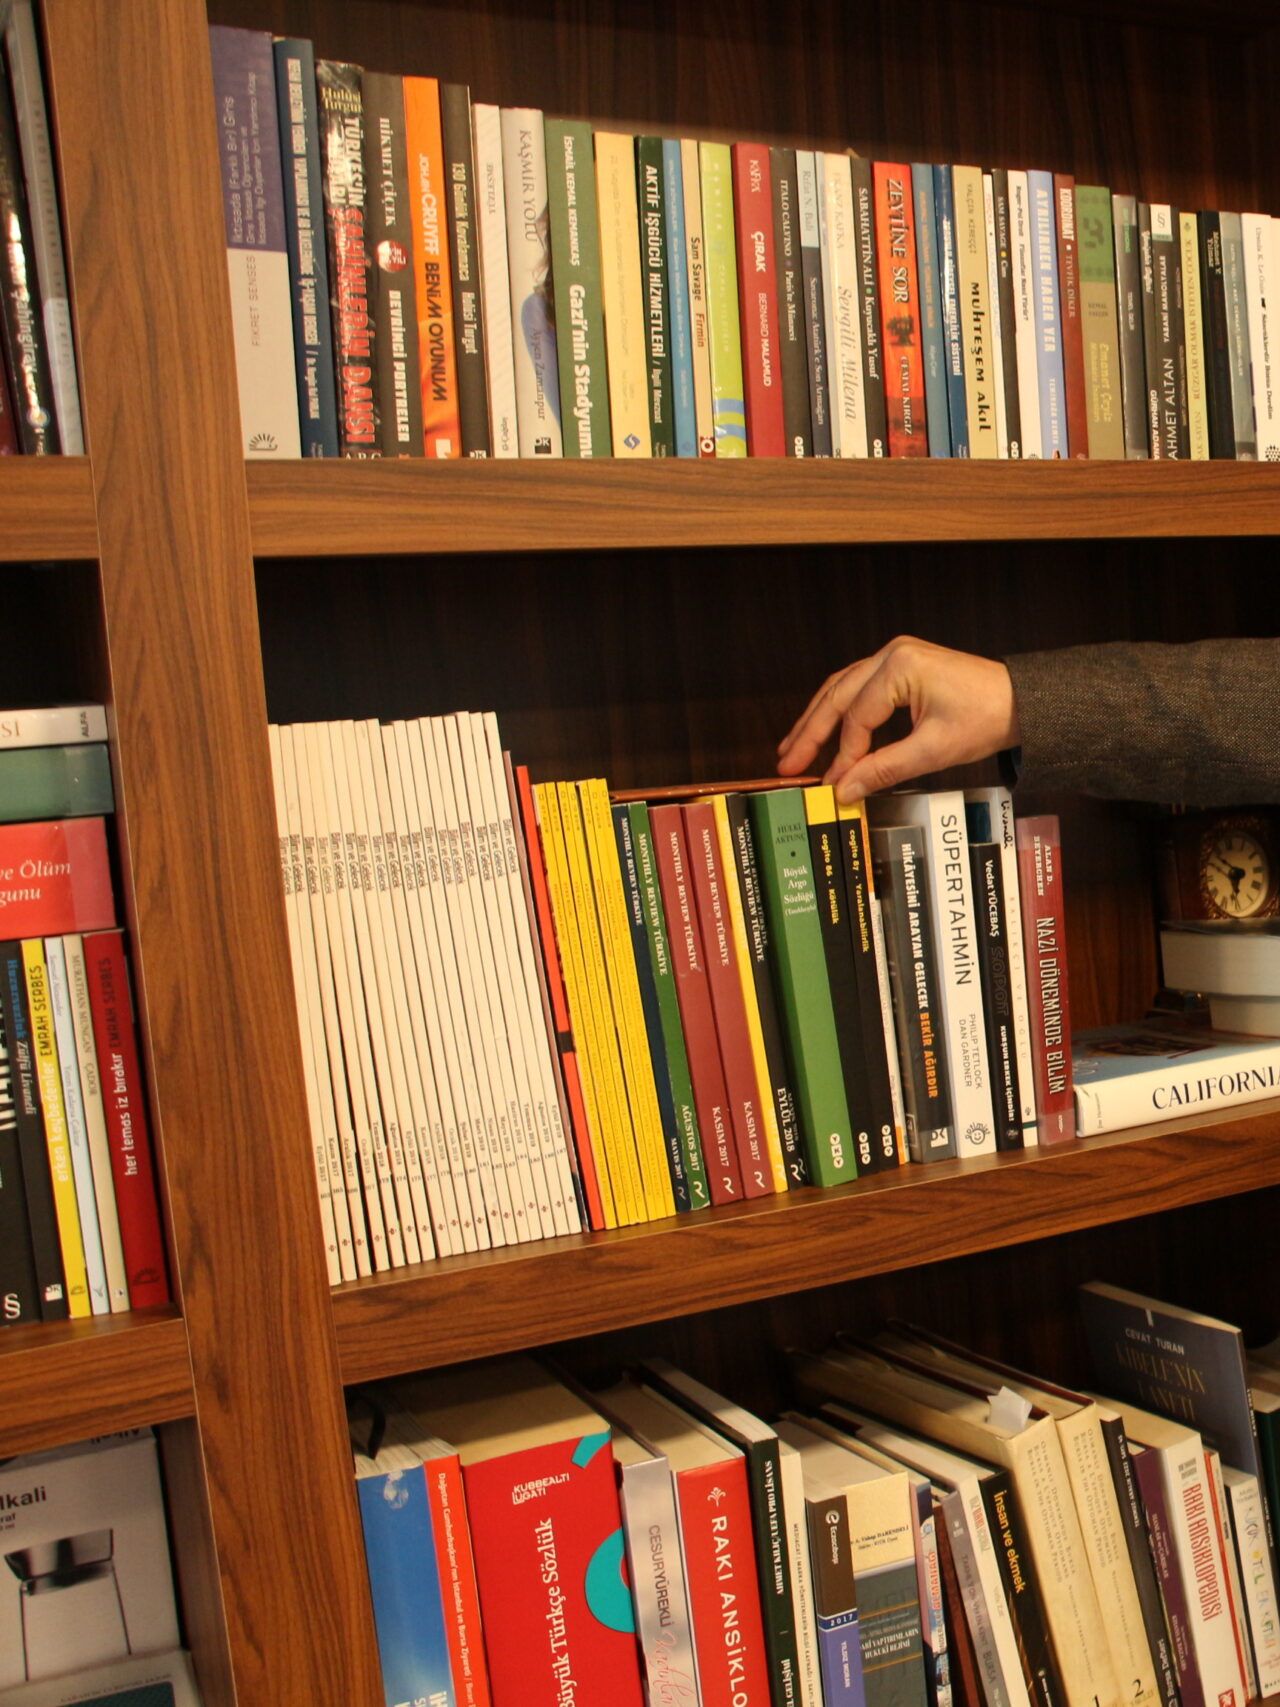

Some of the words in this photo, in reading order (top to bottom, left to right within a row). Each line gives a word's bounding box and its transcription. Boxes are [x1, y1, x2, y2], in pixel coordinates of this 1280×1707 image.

[380, 117, 393, 178] HİKMET
[518, 130, 535, 194] KAŞMİR
[564, 136, 575, 170] İSMAİL
[452, 163, 466, 181] 130
[566, 172, 576, 206] KEMAL
[645, 165, 659, 208] AKTİF
[381, 181, 397, 226] ÇİÇEK
[422, 193, 439, 256] CRUYFF
[523, 198, 537, 243] YOLU
[858, 187, 873, 264] SABAHATTİN
[887, 179, 908, 258] ZEYTİNE
[568, 208, 580, 266] KEMANKAŞ
[645, 212, 662, 267] İŞGÜCÜ
[690, 237, 700, 259] Sam
[751, 231, 766, 272] ÇIRAK
[783, 212, 792, 256] CALVINO
[692, 263, 702, 301] Savage
[863, 265, 874, 285] ALİ
[893, 266, 909, 303] SOR
[648, 272, 665, 357] HİZMETLERİ
[758, 293, 768, 337] BERNARD
[836, 286, 856, 349] Sevgili
[1041, 277, 1054, 321] HABER
[695, 313, 705, 347] Firmin
[1044, 328, 1055, 352] VER
[428, 323, 447, 401] OYUNUM
[761, 338, 772, 386] MALAMUD
[868, 348, 879, 379] Yusuf
[1163, 359, 1175, 406] ALTAN
[342, 366, 375, 443] DANSI
[393, 361, 410, 442] PORTRELER
[842, 354, 858, 424] Milena
[1165, 411, 1177, 461] AHMET
[821, 834, 831, 863] cogito
[849, 830, 859, 858] cogito
[1044, 845, 1052, 872] ALAN
[21, 859, 71, 881] Ölüm
[826, 865, 832, 876] 86
[902, 843, 920, 908] HİKÂYESİNİ
[985, 860, 996, 889] Vedat
[828, 889, 839, 924] Kötülük
[941, 815, 975, 985] SÜPERTAHMİN
[987, 891, 999, 937] YÜCEBAŞ
[908, 912, 923, 958] ARAYAN
[1037, 917, 1058, 953] NAZİ
[29, 966, 46, 1010] SERBES
[639, 833, 652, 884] MONTHLY
[647, 887, 659, 927] REVIEW
[654, 930, 667, 976] TÜRKİYE
[681, 1105, 696, 1150] AĞUSTOS
[690, 1152, 700, 1171] 2017
[670, 832, 682, 883] MONTHLY
[677, 885, 689, 922] REVIEW
[684, 924, 698, 970] TÜRKİYE
[712, 1107, 724, 1144] KASIM
[718, 1146, 729, 1166] 2017
[702, 829, 714, 879] MONTHLY
[709, 882, 721, 919] REVIEW
[716, 920, 729, 966] TÜRKİYE
[743, 1101, 755, 1138] KASIM
[749, 1141, 760, 1160] 2017
[737, 826, 750, 875] MONTHLY
[744, 878, 756, 916] REVIEW
[752, 919, 764, 962] TÜRKİYE
[777, 1088, 790, 1127] EYLÜL
[784, 1130, 795, 1152] 2018
[914, 962, 928, 1009] GELECEK
[1039, 957, 1063, 1047] DÖNEMİNDE
[37, 1017, 52, 1056] EMRAH
[919, 1012, 934, 1047] BEKİR
[959, 1019, 967, 1040] DAN
[969, 1014, 978, 1045] PHILIP
[924, 1051, 938, 1098] AĞIRDIR
[961, 1042, 972, 1087] GARDNER
[972, 1047, 982, 1090] TETLOCK
[1003, 1061, 1011, 1086] ERKEK
[1047, 1050, 1067, 1095] BİLİM
[21, 1073, 36, 1114] Livaneli
[41, 1062, 62, 1142] kaybedenler
[116, 1097, 128, 1108] iz
[121, 1113, 134, 1151] temas
[54, 1147, 68, 1182] erken
[124, 1154, 138, 1176] her
[514, 1473, 570, 1493] KUBBEALTI
[1183, 1483, 1207, 1521] RAKI
[994, 1490, 1009, 1529] İnsan
[535, 1518, 559, 1584] Sözlük
[712, 1516, 733, 1580] RAKI
[1003, 1531, 1014, 1546] ve
[1007, 1549, 1025, 1593] ekmek
[546, 1586, 566, 1653] Türkçe
[721, 1593, 747, 1707] ANSİKLO
